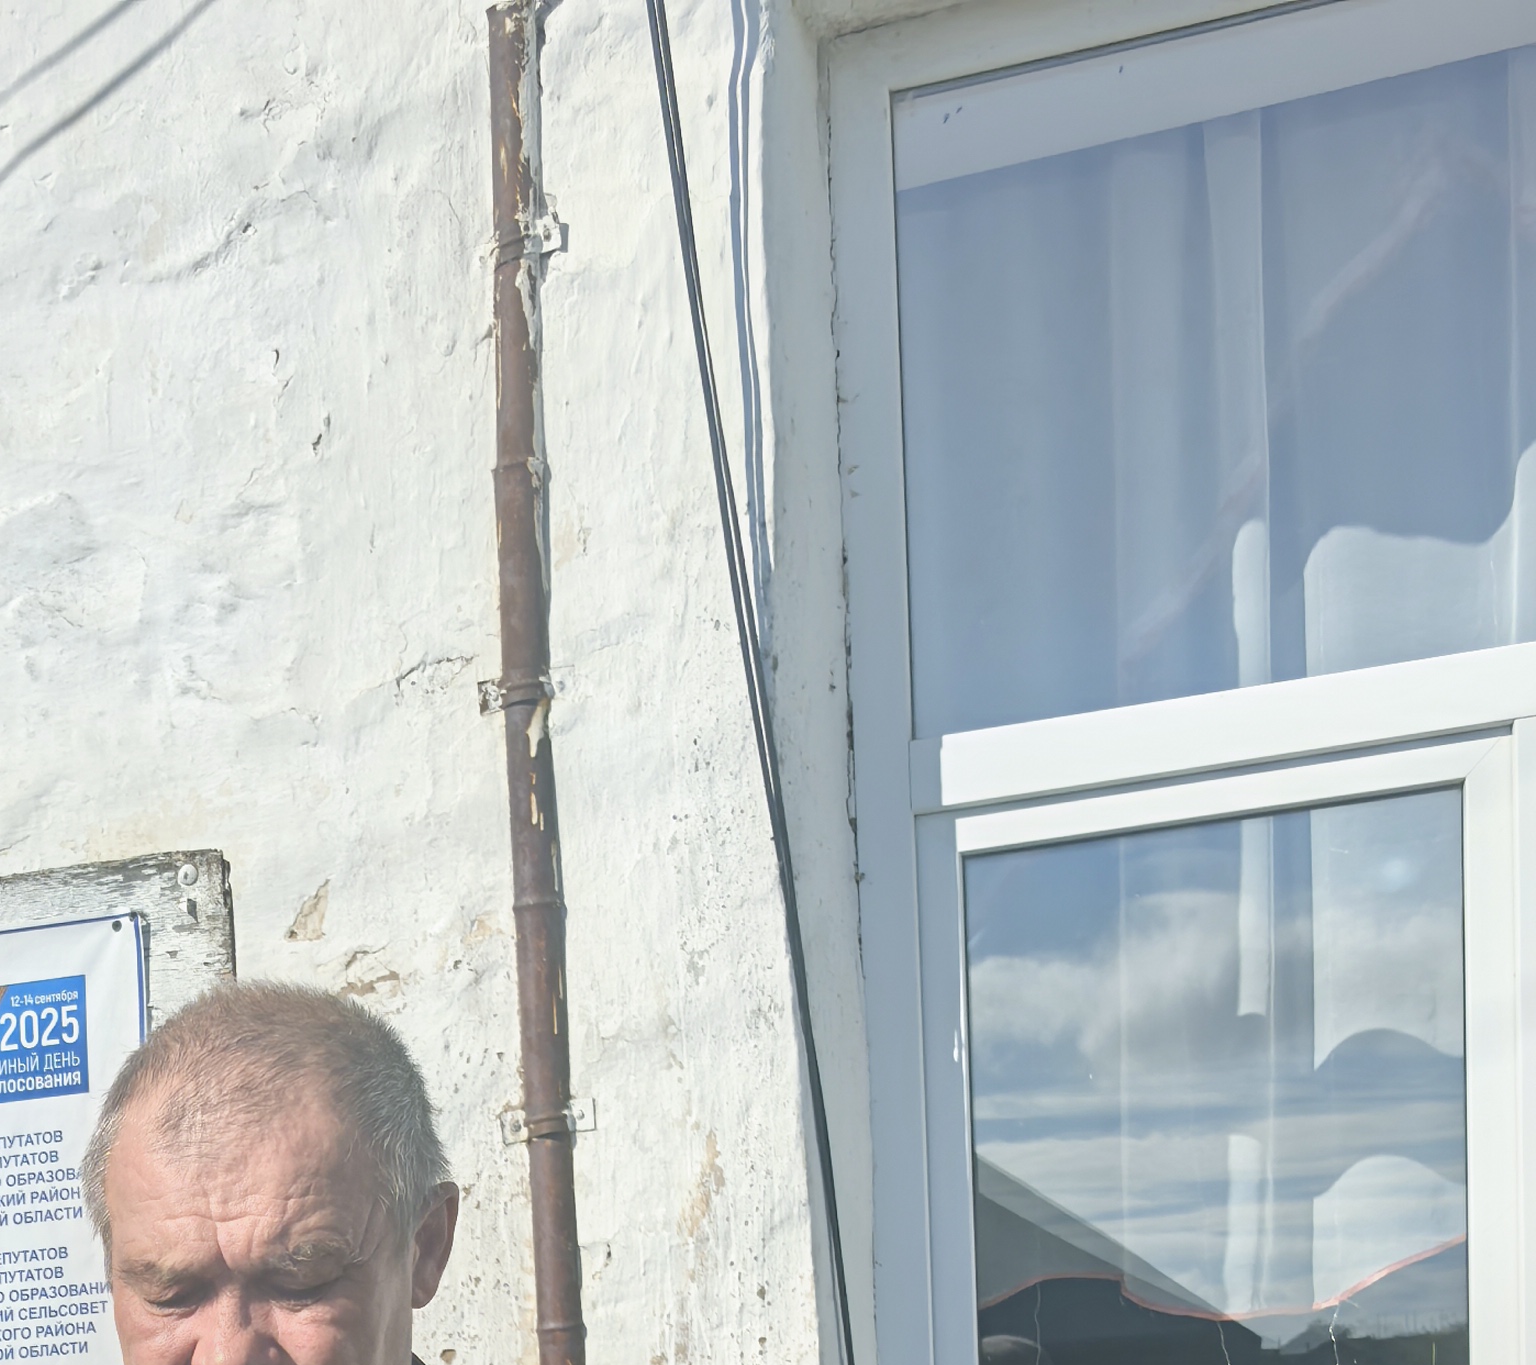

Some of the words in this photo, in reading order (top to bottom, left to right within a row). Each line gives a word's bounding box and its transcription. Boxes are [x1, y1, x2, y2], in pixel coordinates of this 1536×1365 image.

[11, 995, 33, 1007] 12-14
[35, 989, 78, 1005] сентября
[0, 1005, 79, 1051] 2025
[44, 1051, 80, 1072] ДЕНЬ
[6, 1167, 81, 1186] ОБРАЗОВ
[31, 1186, 80, 1204] РАЙОН
[13, 1206, 82, 1224] ОБЛАСТИ
[19, 1301, 108, 1320] СЕЛЬСОВЕТ
[36, 1320, 96, 1338] РАЙОНА
[19, 1342, 88, 1358] ОБЛАСТИ
